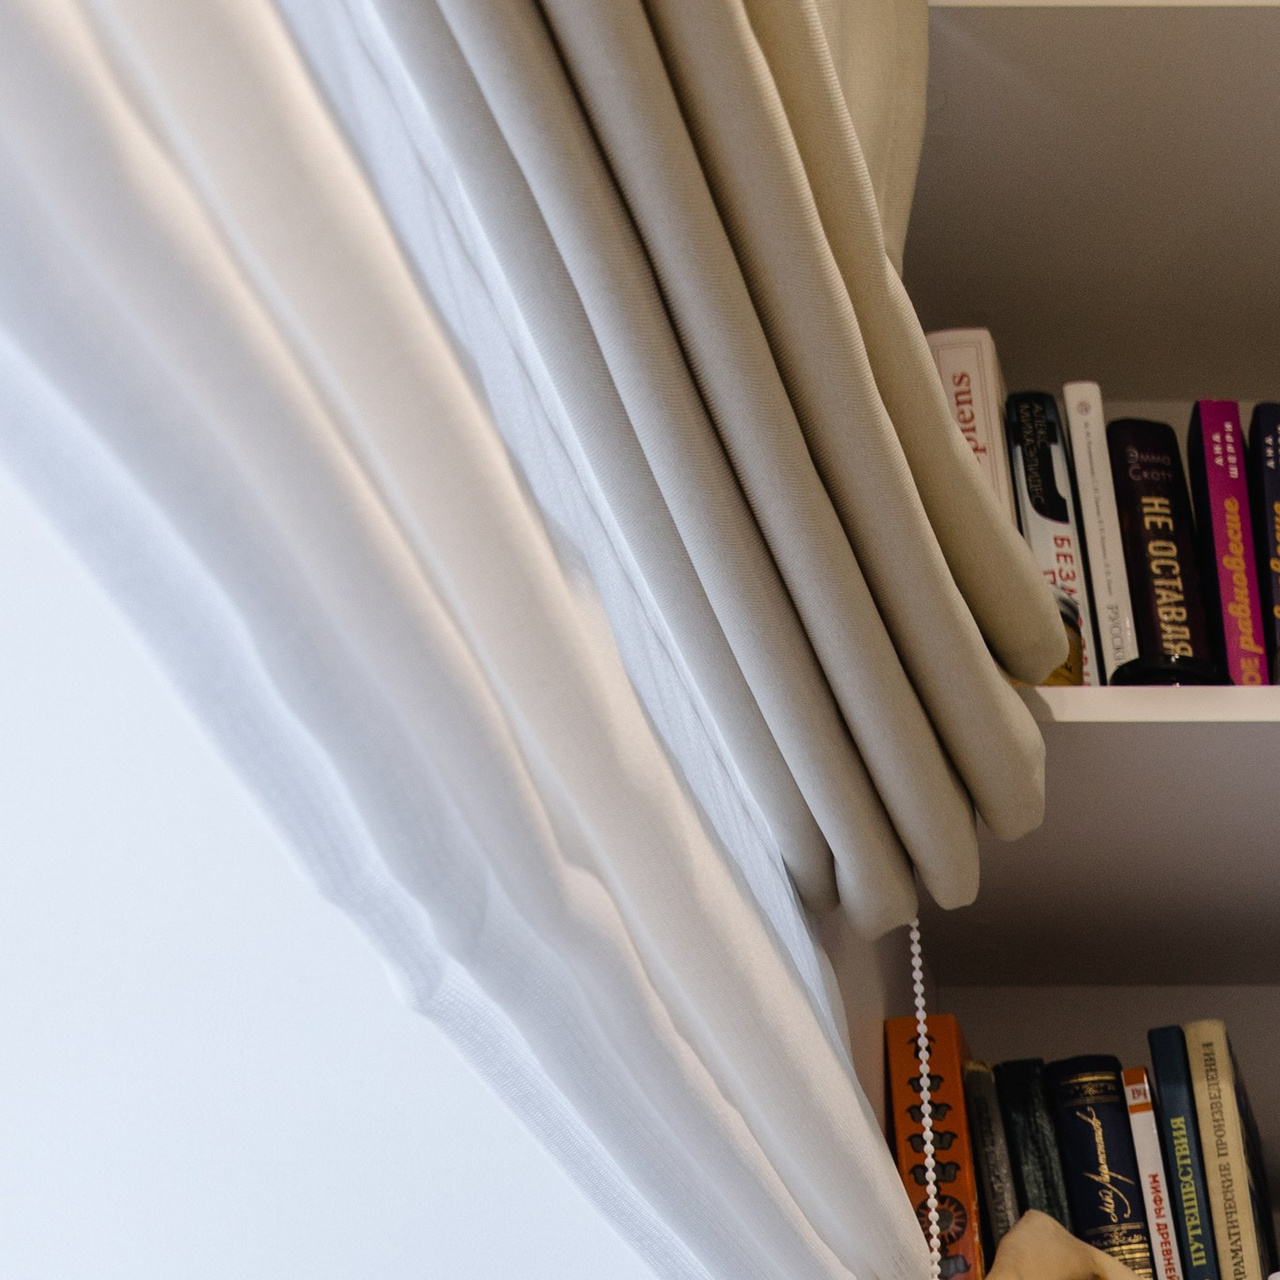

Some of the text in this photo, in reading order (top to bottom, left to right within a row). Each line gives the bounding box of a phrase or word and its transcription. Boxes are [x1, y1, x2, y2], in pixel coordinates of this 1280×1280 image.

[1140, 495, 1174, 532] НЕ
[1202, 1041, 1228, 1158] ПРОИЗВЕДЕНИЯ
[1147, 1173, 1167, 1219] МИФЫ
[1170, 1115, 1207, 1266] ПУТЕШЕСТВИЯ
